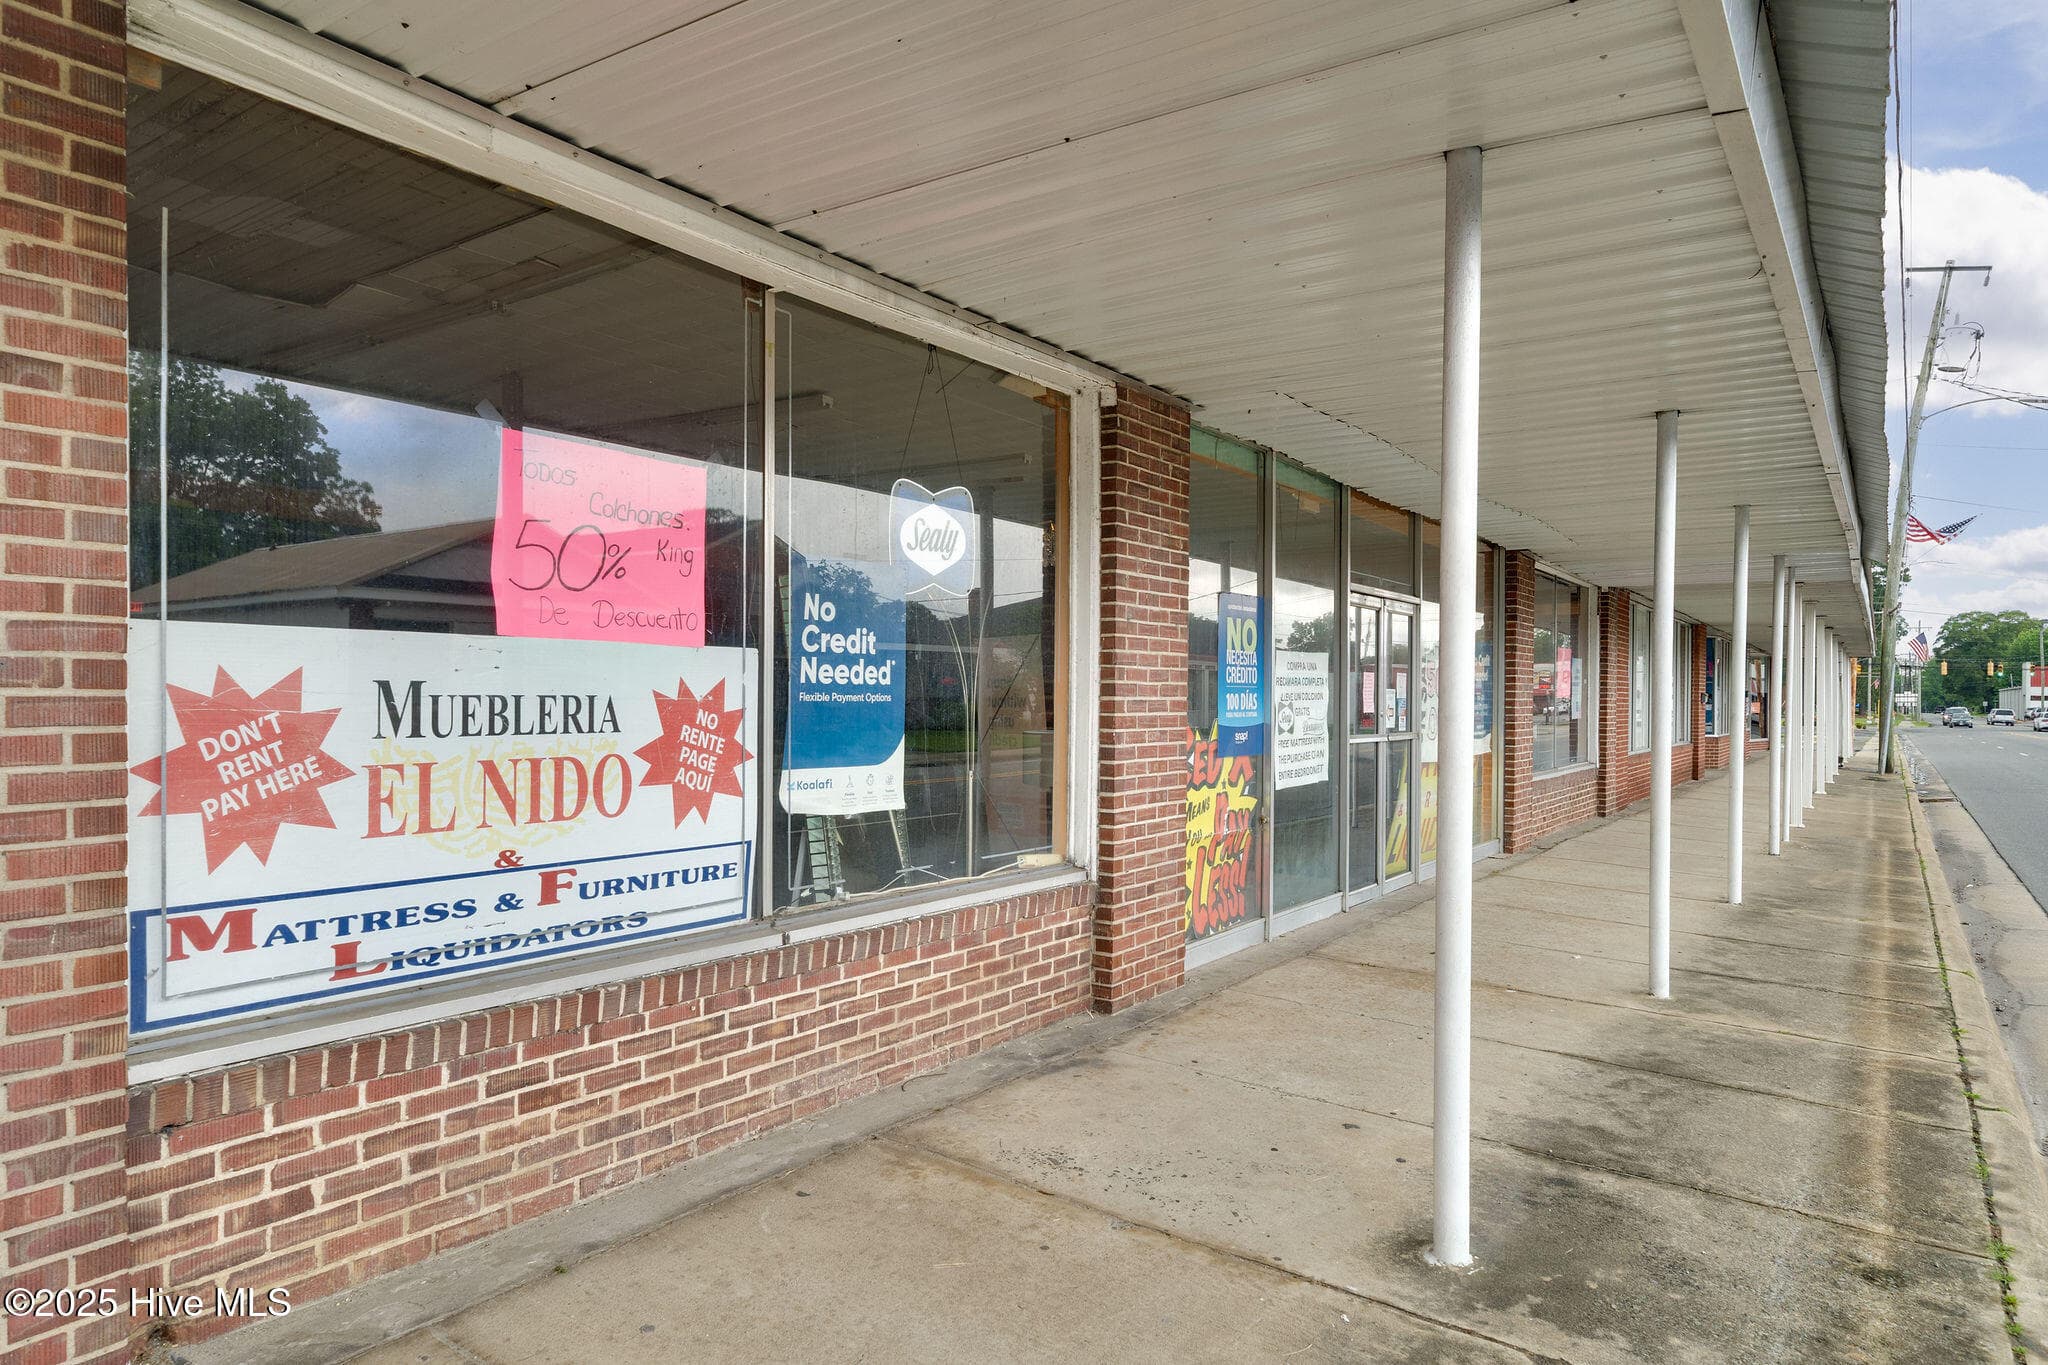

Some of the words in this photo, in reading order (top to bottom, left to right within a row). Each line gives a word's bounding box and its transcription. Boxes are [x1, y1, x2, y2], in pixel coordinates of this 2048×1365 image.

[907, 518, 959, 560] Sealy
[509, 519, 632, 591] 50%
[657, 539, 694, 577] King
[539, 596, 569, 625] De
[592, 599, 698, 631] Descuento
[803, 592, 836, 622] No
[801, 624, 877, 655] Credit
[1226, 616, 1257, 652] NO
[1226, 649, 1257, 666] NECESITA
[1226, 664, 1257, 684] CRÉDITO
[372, 680, 621, 739] MUEBLERIA
[799, 692, 830, 702] Flexible
[832, 692, 864, 704] Payment
[865, 693, 892, 703] Options
[1226, 692, 1239, 711] 100
[1240, 689, 1257, 711] DÍAS
[696, 709, 718, 730] NO
[197, 711, 283, 762] DON'T
[680, 724, 726, 755] RENTE
[217, 740, 284, 785] RENT
[679, 746, 718, 773] PAGE
[201, 784, 251, 823] PAY
[255, 756, 323, 800] HERE
[674, 767, 714, 793] AQUÍ
[797, 779, 833, 791] Koalafi
[361, 762, 456, 839] EL
[476, 753, 632, 828] NIDO
[494, 849, 524, 868] &
[166, 898, 477, 962] MATTRESS
[494, 893, 524, 913] &
[537, 862, 738, 906] FURNITURE
[329, 911, 649, 982] LIQUIDATORS
